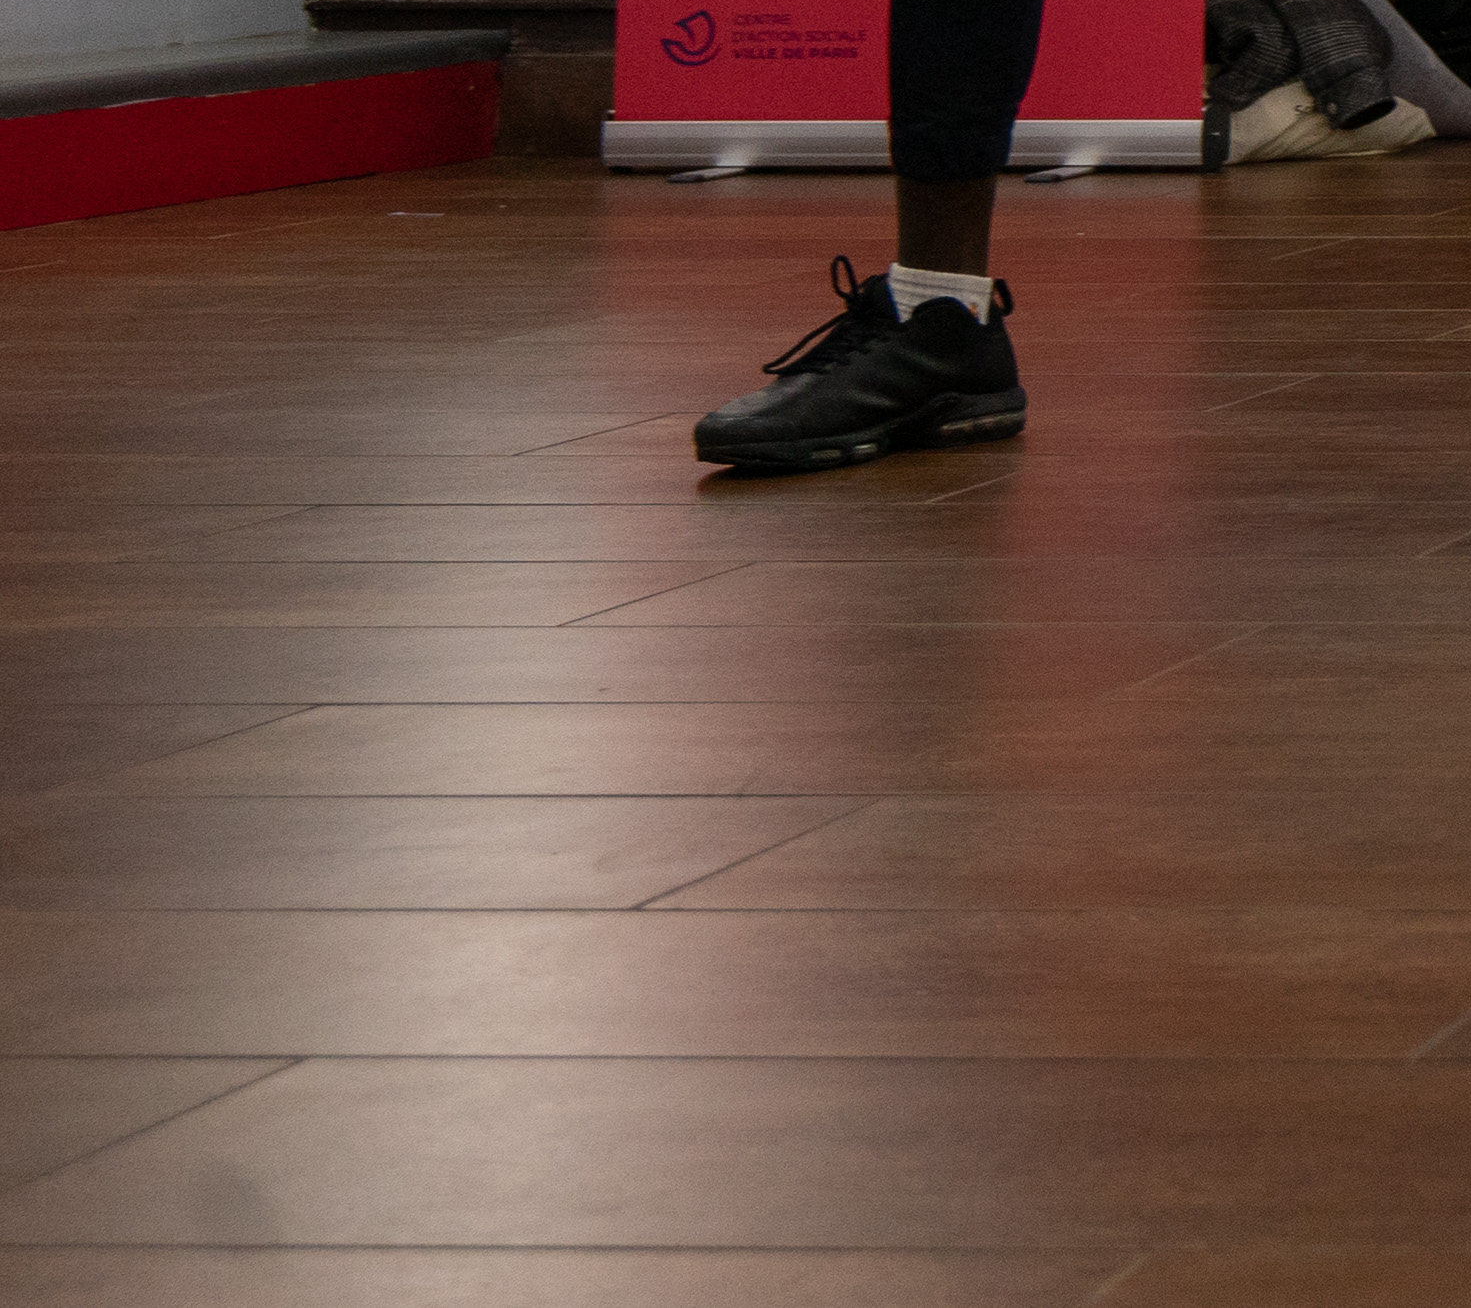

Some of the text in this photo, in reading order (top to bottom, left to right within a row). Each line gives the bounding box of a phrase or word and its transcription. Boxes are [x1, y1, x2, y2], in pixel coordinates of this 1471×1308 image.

[730, 46, 859, 60] VILLE DE PARIS
